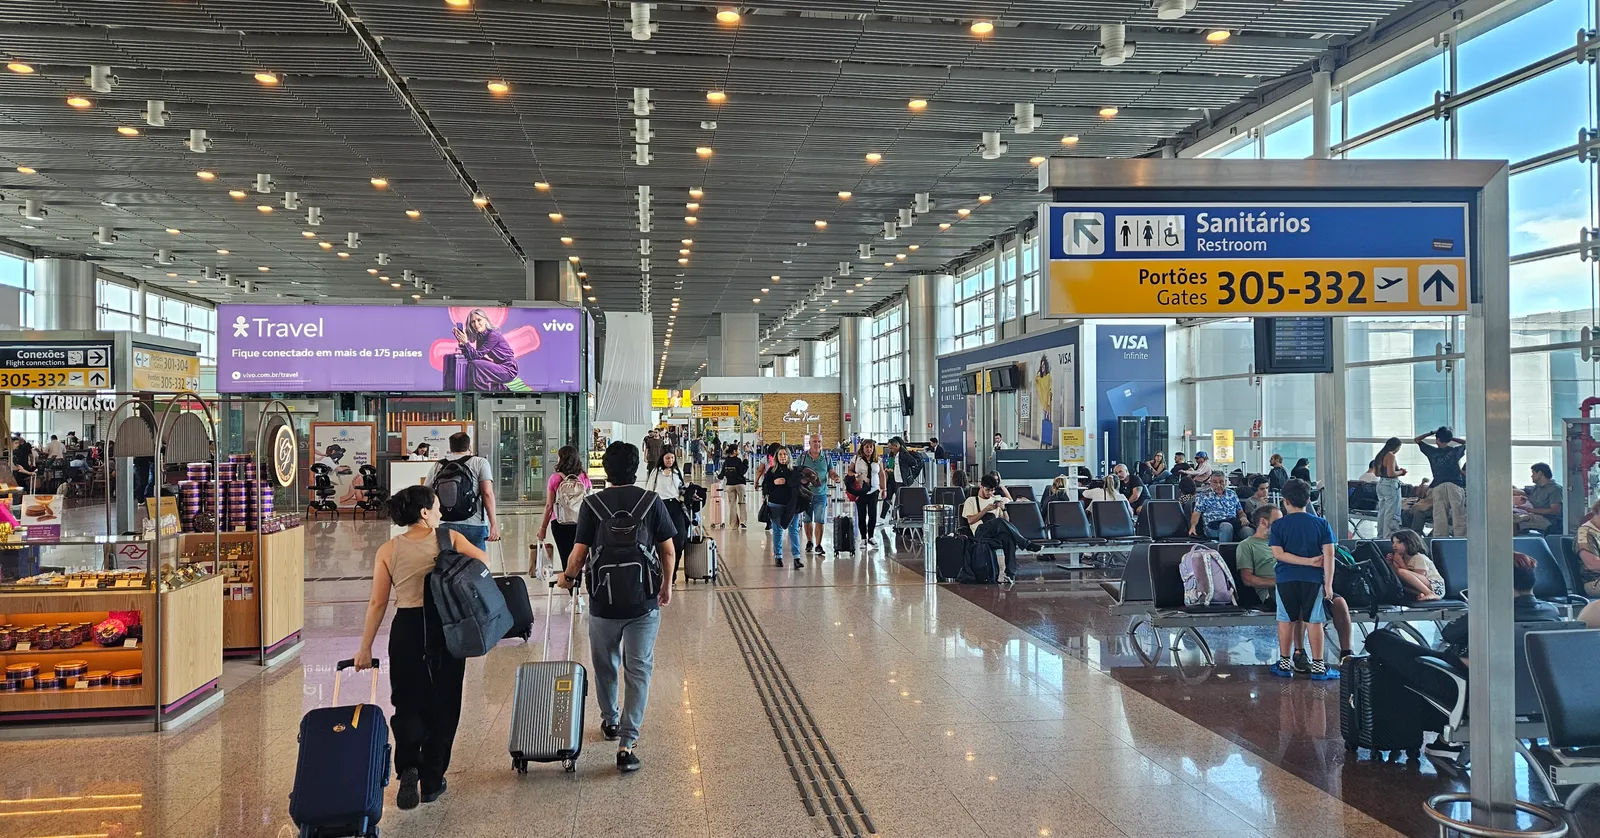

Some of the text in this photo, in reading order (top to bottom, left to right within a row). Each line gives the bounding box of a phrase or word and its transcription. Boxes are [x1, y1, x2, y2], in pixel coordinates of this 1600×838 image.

[1196, 211, 1311, 235] Sanitários
[1197, 237, 1267, 253] Restroom
[1138, 268, 1208, 286] Portões
[1217, 271, 1367, 305] 305-332
[1156, 289, 1208, 306] Gates
[253, 318, 323, 337] Travel
[542, 319, 574, 331] vivo
[1109, 335, 1148, 350] VISA
[17, 349, 65, 359] Conexões
[231, 347, 423, 360] Fique conectado em mais de 175 países
[1058, 352, 1072, 365] VISA
[1123, 351, 1149, 361] Infinite
[5, 359, 66, 368] Flight connections
[164, 357, 188, 372] 301-304
[0, 373, 66, 387] 305-332
[242, 371, 299, 380] vivo.com.br/travel
[161, 376, 185, 390] 305-332
[33, 394, 102, 412] STARBUCKS
